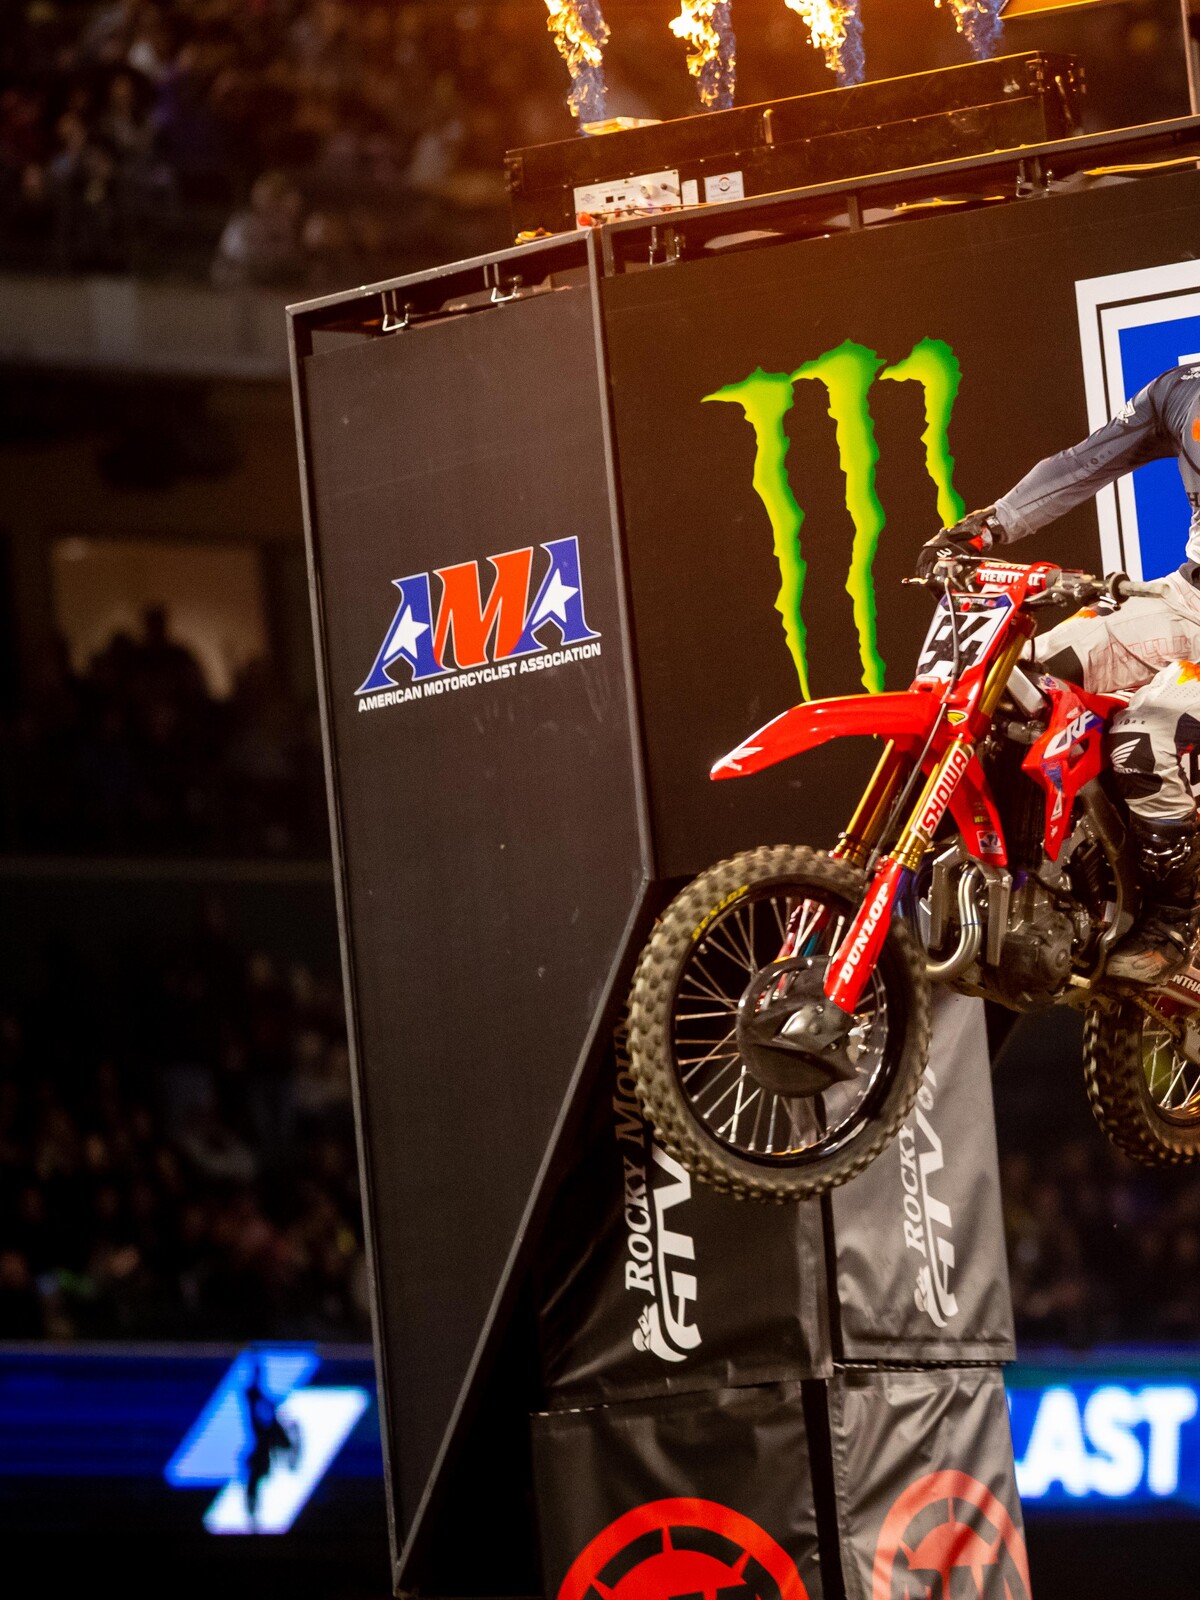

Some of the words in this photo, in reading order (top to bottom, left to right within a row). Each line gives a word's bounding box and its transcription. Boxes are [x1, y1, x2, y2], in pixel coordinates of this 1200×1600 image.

[354, 535, 601, 695] AMA
[358, 685, 422, 712] AMERICAN
[423, 662, 517, 698] MOTORCYCLIST
[519, 642, 601, 674] ASSOCIATION
[1042, 709, 1096, 759] CRF
[921, 747, 968, 834] SHOWA
[838, 882, 889, 983] DUNLOP
[624, 1155, 655, 1297] ROCKY
[899, 1124, 927, 1258] ROCKY
